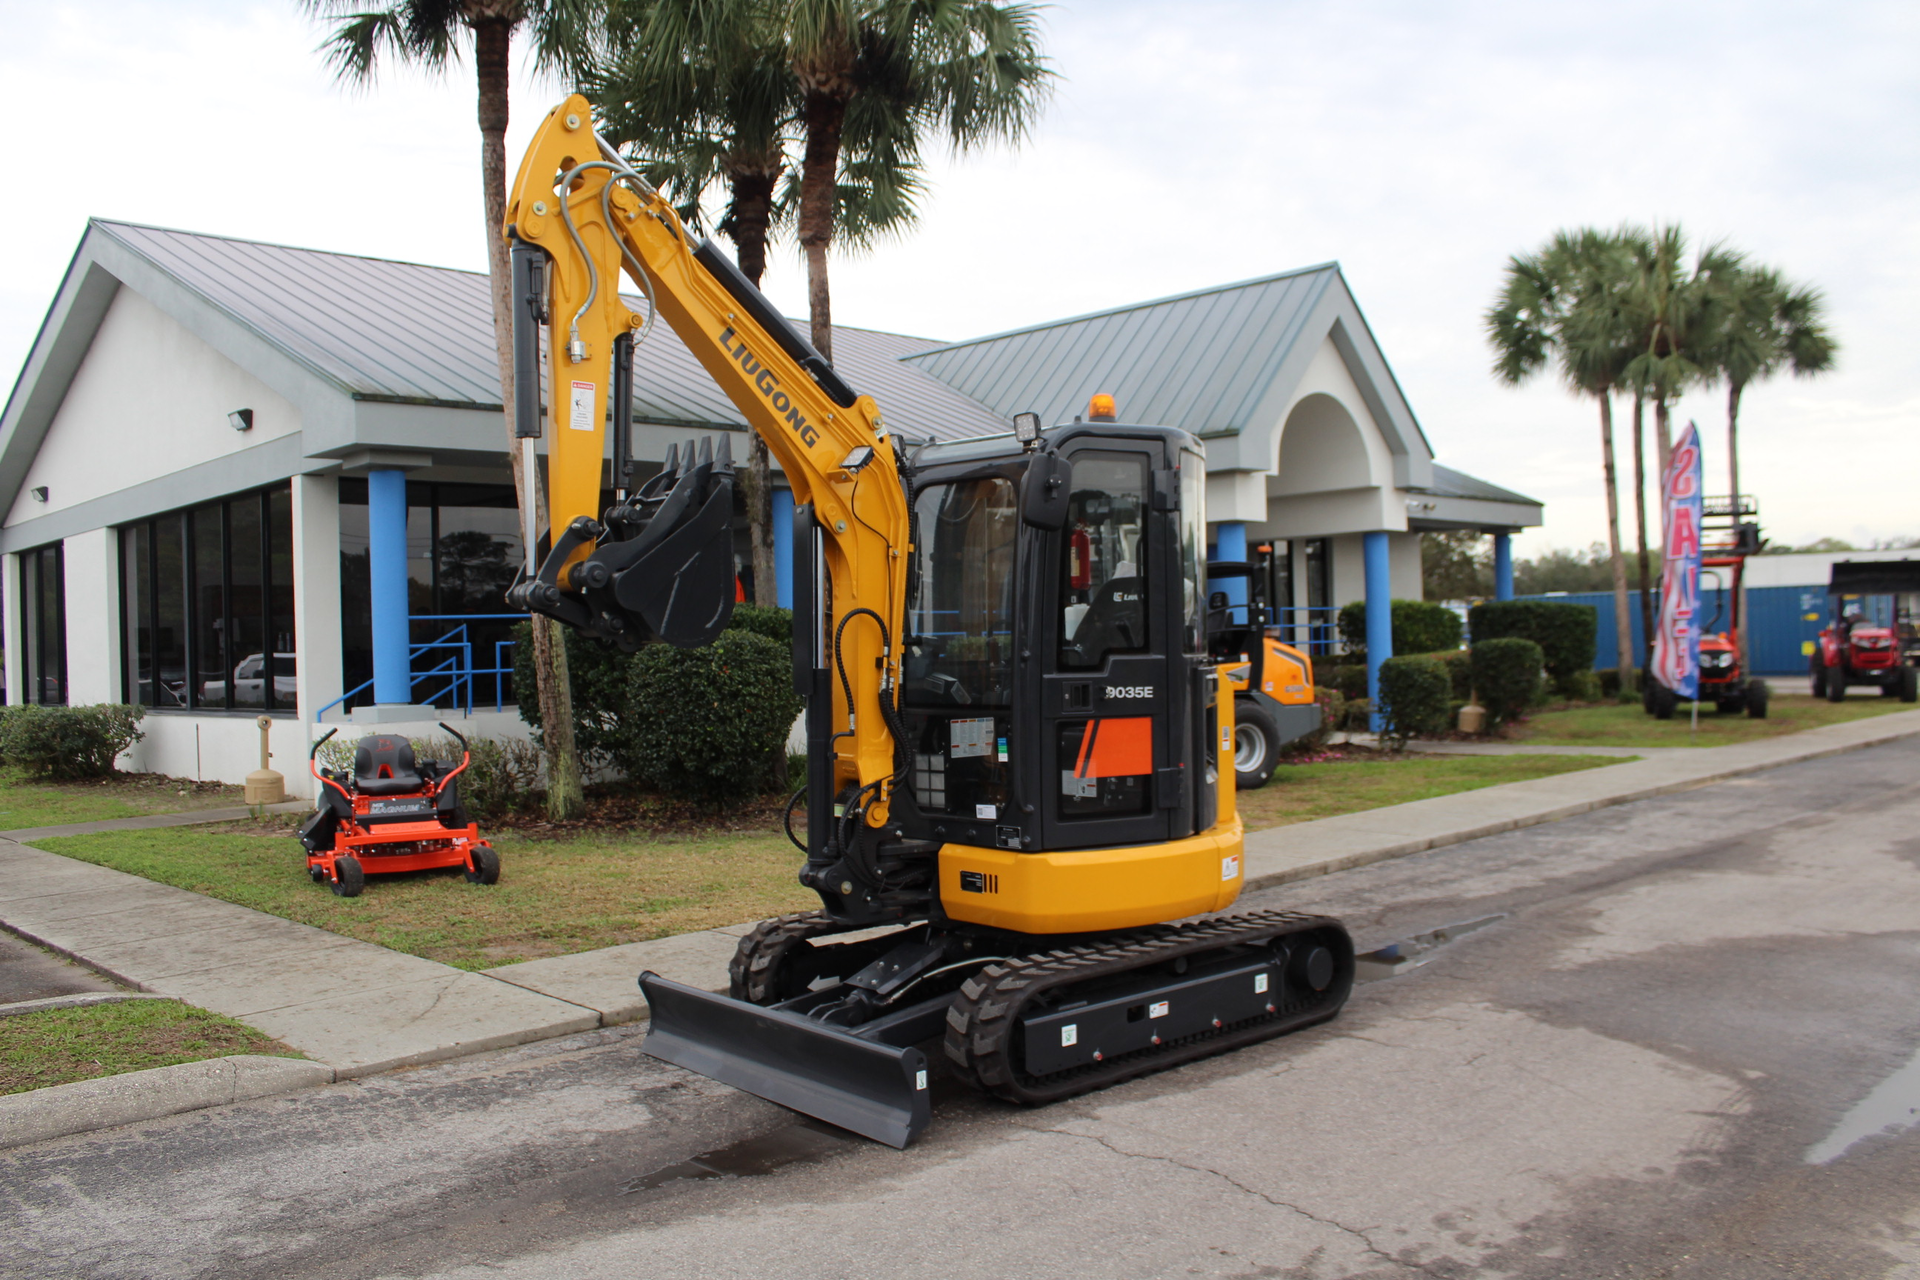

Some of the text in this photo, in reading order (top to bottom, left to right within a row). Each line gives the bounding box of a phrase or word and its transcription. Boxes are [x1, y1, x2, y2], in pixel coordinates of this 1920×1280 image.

[718, 326, 820, 449] LIUGONG
[1105, 685, 1154, 699] 9035E
[369, 804, 420, 815] MAGNUM
